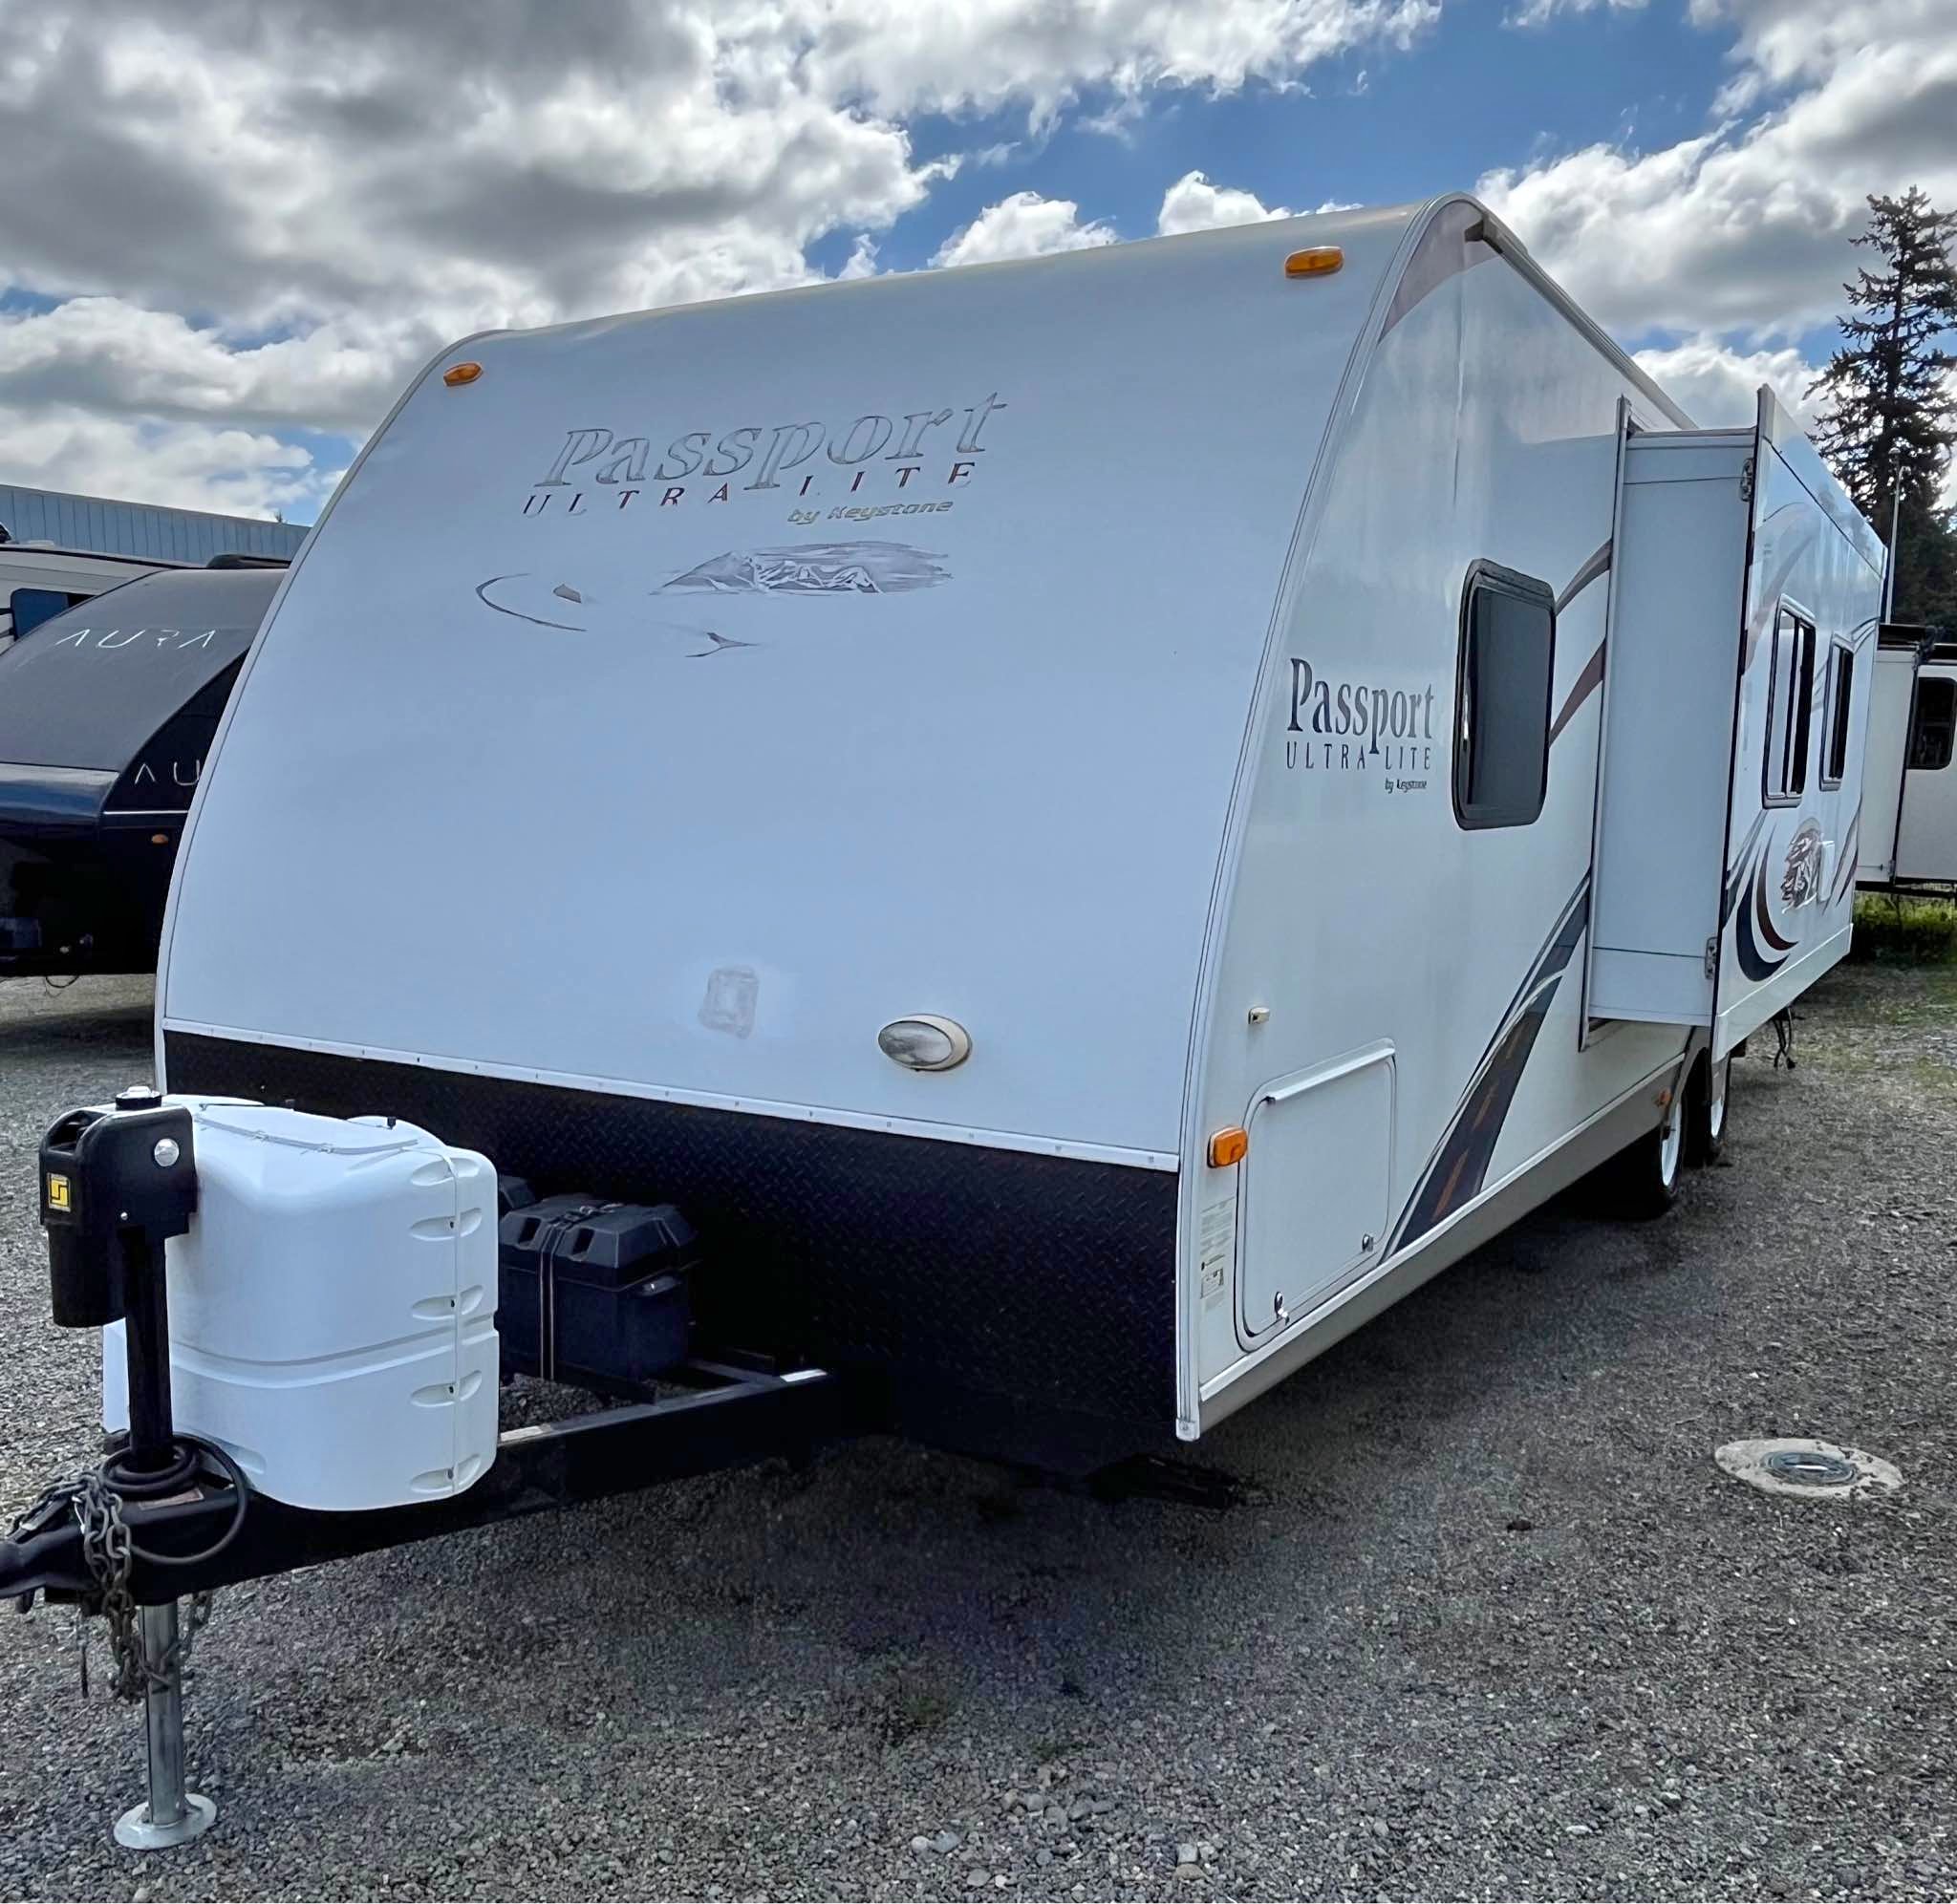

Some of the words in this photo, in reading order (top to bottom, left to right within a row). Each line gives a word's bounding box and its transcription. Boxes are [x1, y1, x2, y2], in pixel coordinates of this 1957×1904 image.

[533, 391, 1008, 490] Passport
[522, 481, 729, 519] ULTRA
[799, 461, 976, 497] LITE
[786, 508, 820, 525] by
[827, 501, 954, 522] Keystone
[1286, 656, 1434, 755] Passport
[1286, 740, 1366, 770] ULTRA
[1385, 745, 1431, 771] LITE
